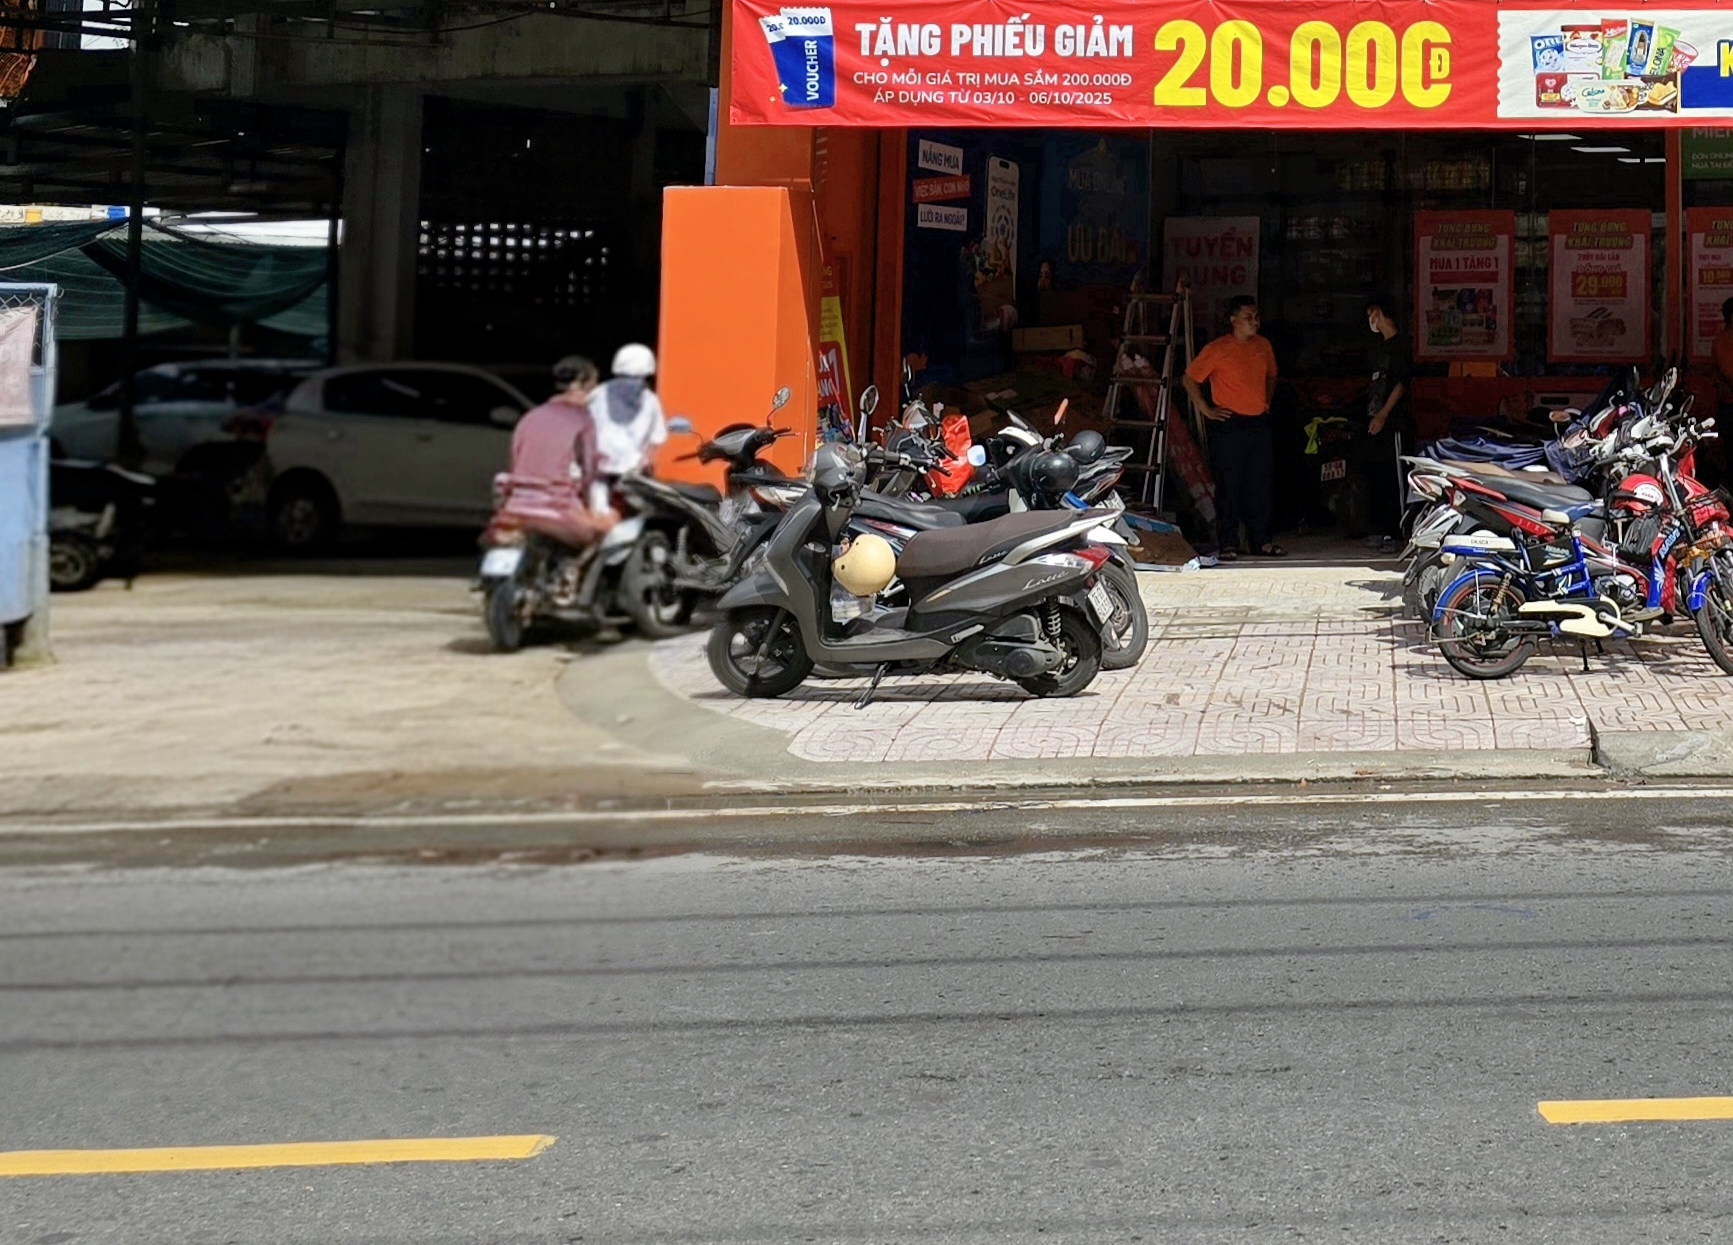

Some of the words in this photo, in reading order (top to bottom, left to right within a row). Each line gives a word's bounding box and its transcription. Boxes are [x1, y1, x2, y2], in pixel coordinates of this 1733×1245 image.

[855, 16, 942, 67] TẶNG
[951, 13, 1045, 57] PHIẾU
[1054, 14, 1134, 57] GIẢM
[804, 40, 820, 101] VOUCHER
[853, 71, 888, 86] CHO
[892, 68, 924, 86] MỖI
[926, 69, 951, 86] GIÁ
[956, 72, 981, 89] TRỊ
[985, 72, 1020, 86] MUA
[1024, 68, 1058, 86] SẮM
[1062, 72, 1132, 86] 200.000Đ
[873, 88, 895, 104] ÁP
[899, 91, 944, 106] DỤNG
[948, 89, 971, 104] TỪ
[973, 91, 1015, 106] 03/10
[1029, 91, 1113, 106] 06/10/2025
[1430, 257, 1452, 270] MUA
